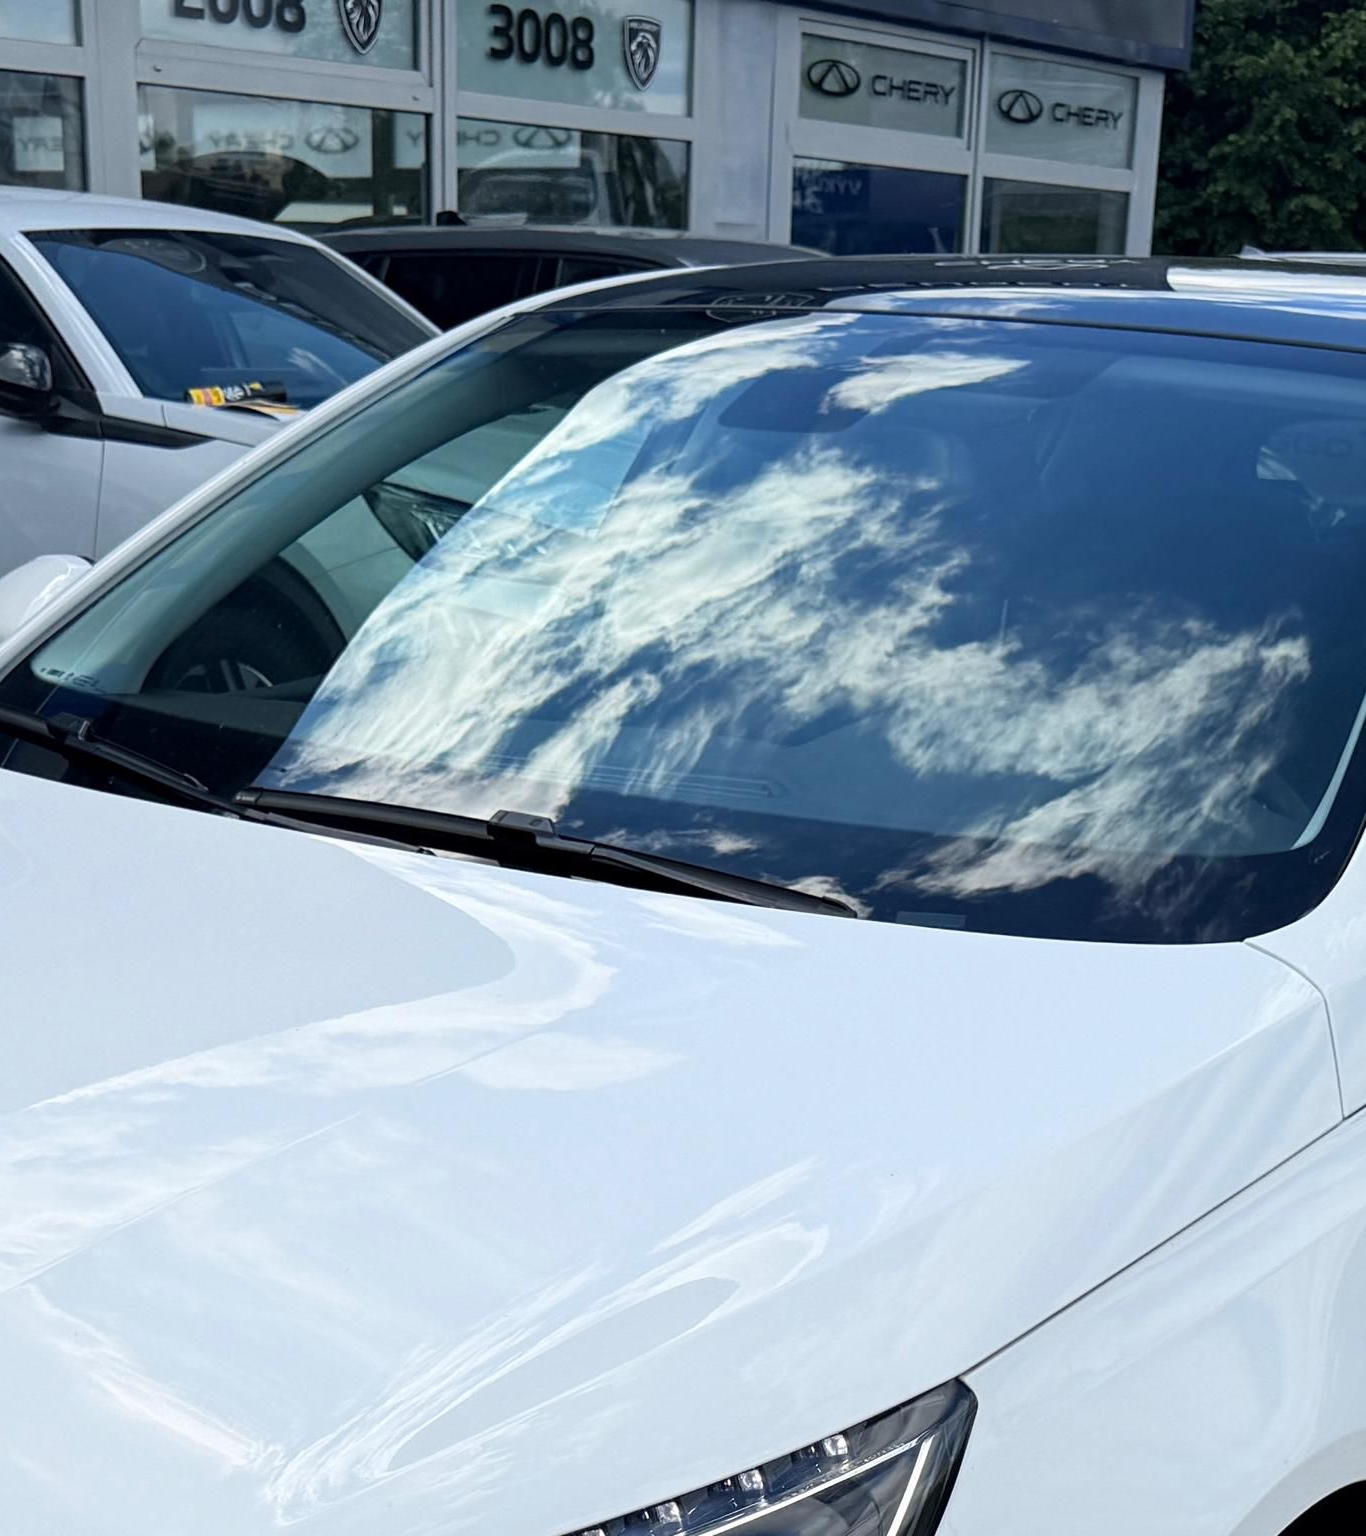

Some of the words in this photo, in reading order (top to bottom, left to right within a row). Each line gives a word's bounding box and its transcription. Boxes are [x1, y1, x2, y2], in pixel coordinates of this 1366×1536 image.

[488, 3, 595, 70] 3008
[871, 74, 956, 106] CHERY
[1051, 102, 1124, 130] CHERY
